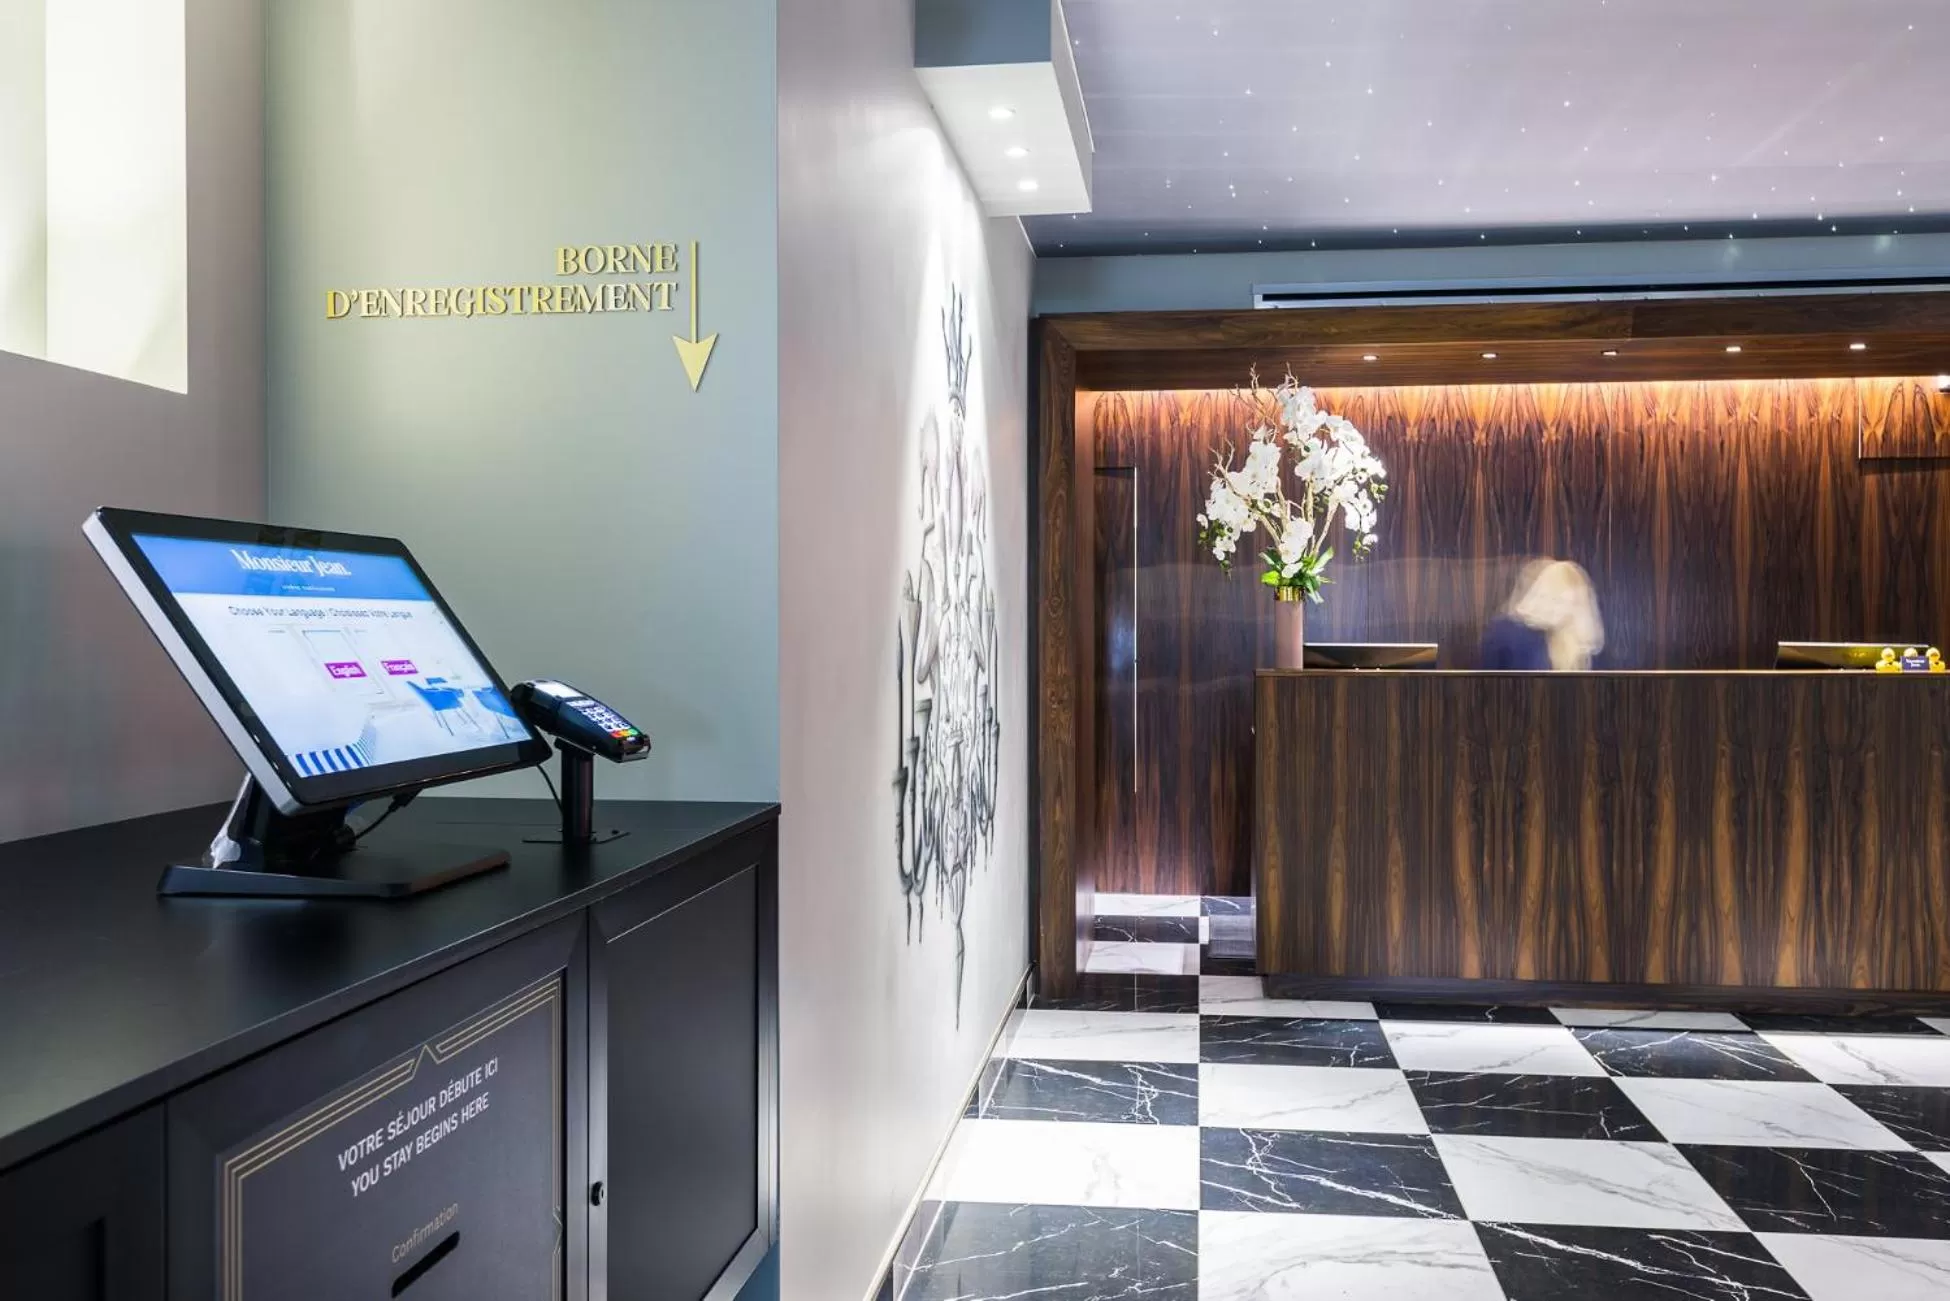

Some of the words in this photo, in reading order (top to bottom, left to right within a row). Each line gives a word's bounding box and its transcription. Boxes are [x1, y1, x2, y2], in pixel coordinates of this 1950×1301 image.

[556, 243, 679, 275] BORNE
[230, 549, 313, 572] Monsieur
[228, 605, 264, 617] Choose
[262, 606, 286, 617] Your
[330, 664, 362, 677] English
[337, 1127, 385, 1171] VOTRE
[387, 1096, 437, 1141] SÉJOUR
[439, 1066, 483, 1108] DÉBUTE
[484, 1057, 499, 1079] ICI
[351, 1164, 380, 1197] YOU
[382, 1141, 414, 1177] STAY
[415, 1112, 459, 1155] BEGINS
[460, 1091, 490, 1124] HERE
[391, 1202, 459, 1264] Confirmation
